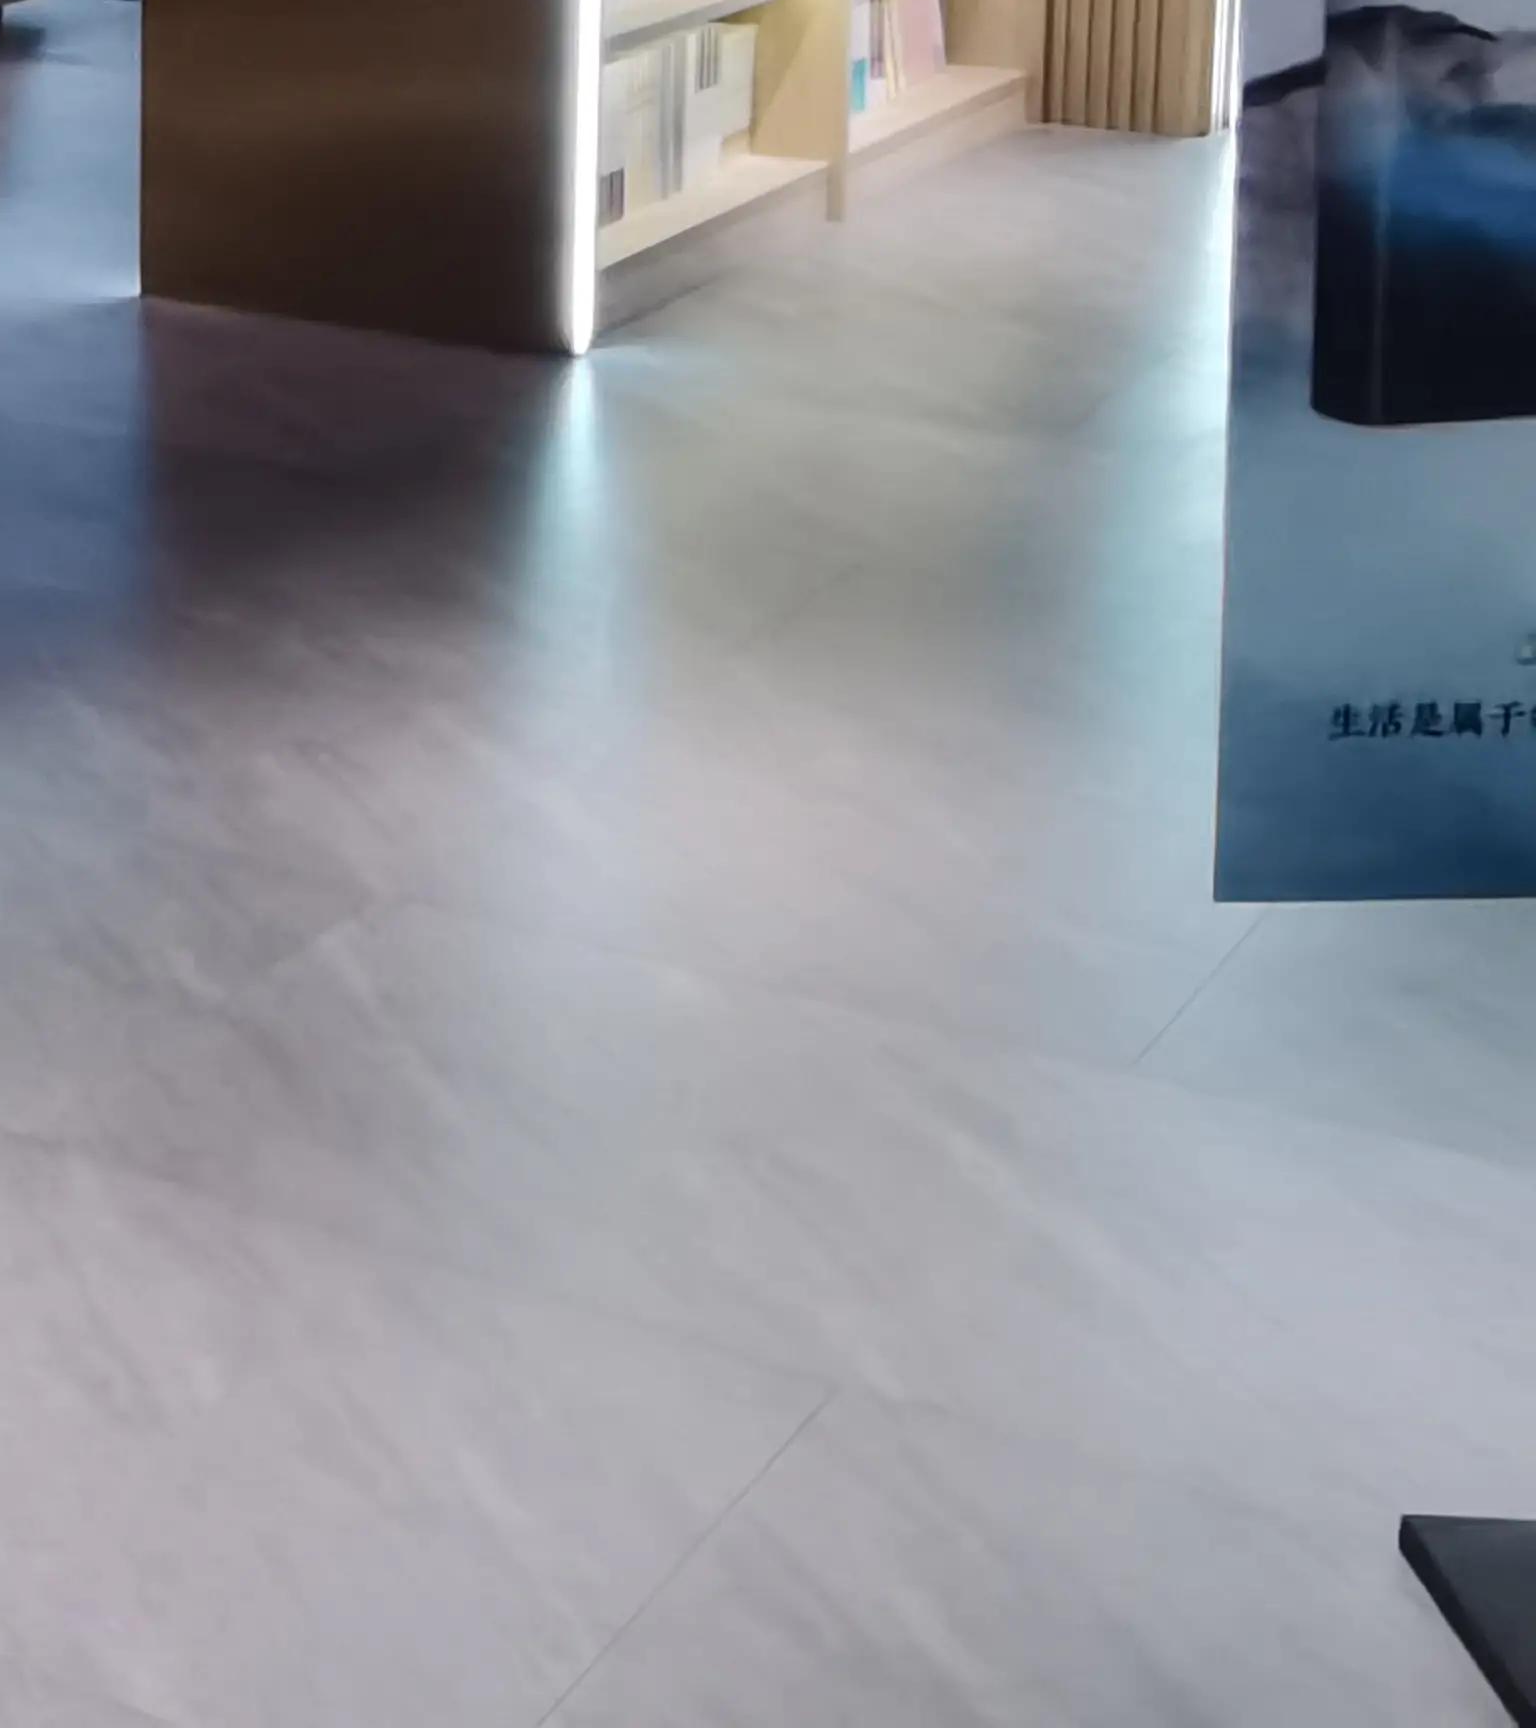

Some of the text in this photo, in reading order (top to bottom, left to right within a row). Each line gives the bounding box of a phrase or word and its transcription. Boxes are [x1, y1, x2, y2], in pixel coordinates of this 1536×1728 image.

[1328, 698, 1536, 741] 生活是属于
